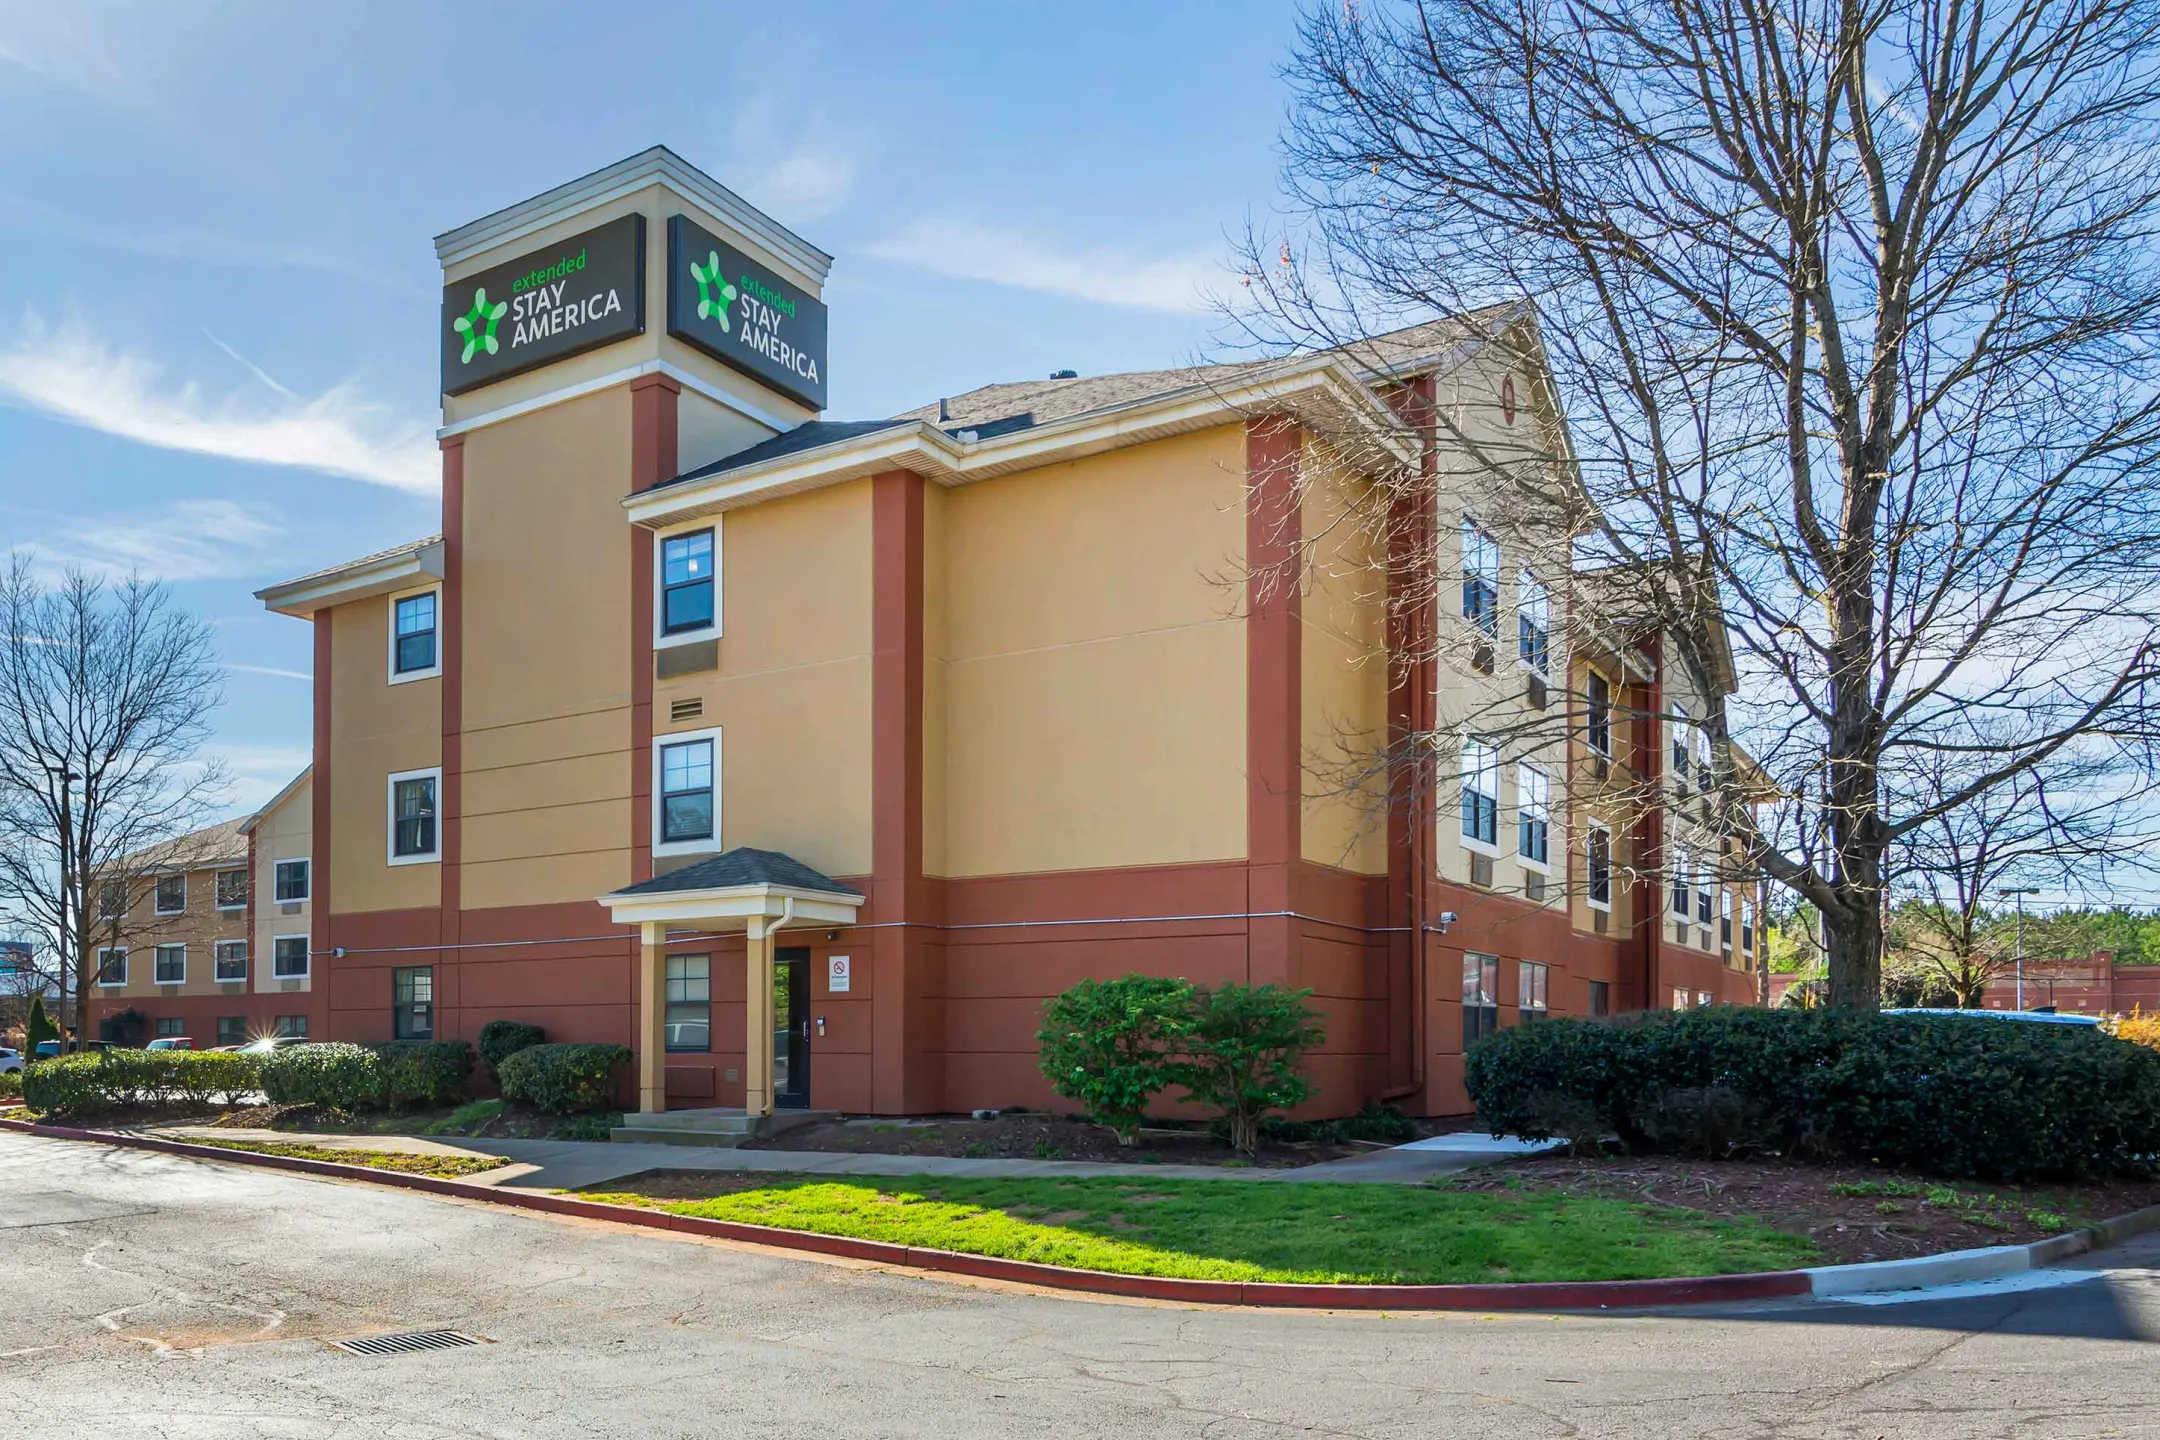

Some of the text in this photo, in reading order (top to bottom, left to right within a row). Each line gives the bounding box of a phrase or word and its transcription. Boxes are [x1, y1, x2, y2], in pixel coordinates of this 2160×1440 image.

[512, 248, 586, 292] extended
[511, 288, 622, 348] AMERICA
[512, 280, 567, 321] STAY
[740, 274, 796, 319] extended
[741, 293, 782, 336] STAY
[740, 324, 819, 385] AMERICA
